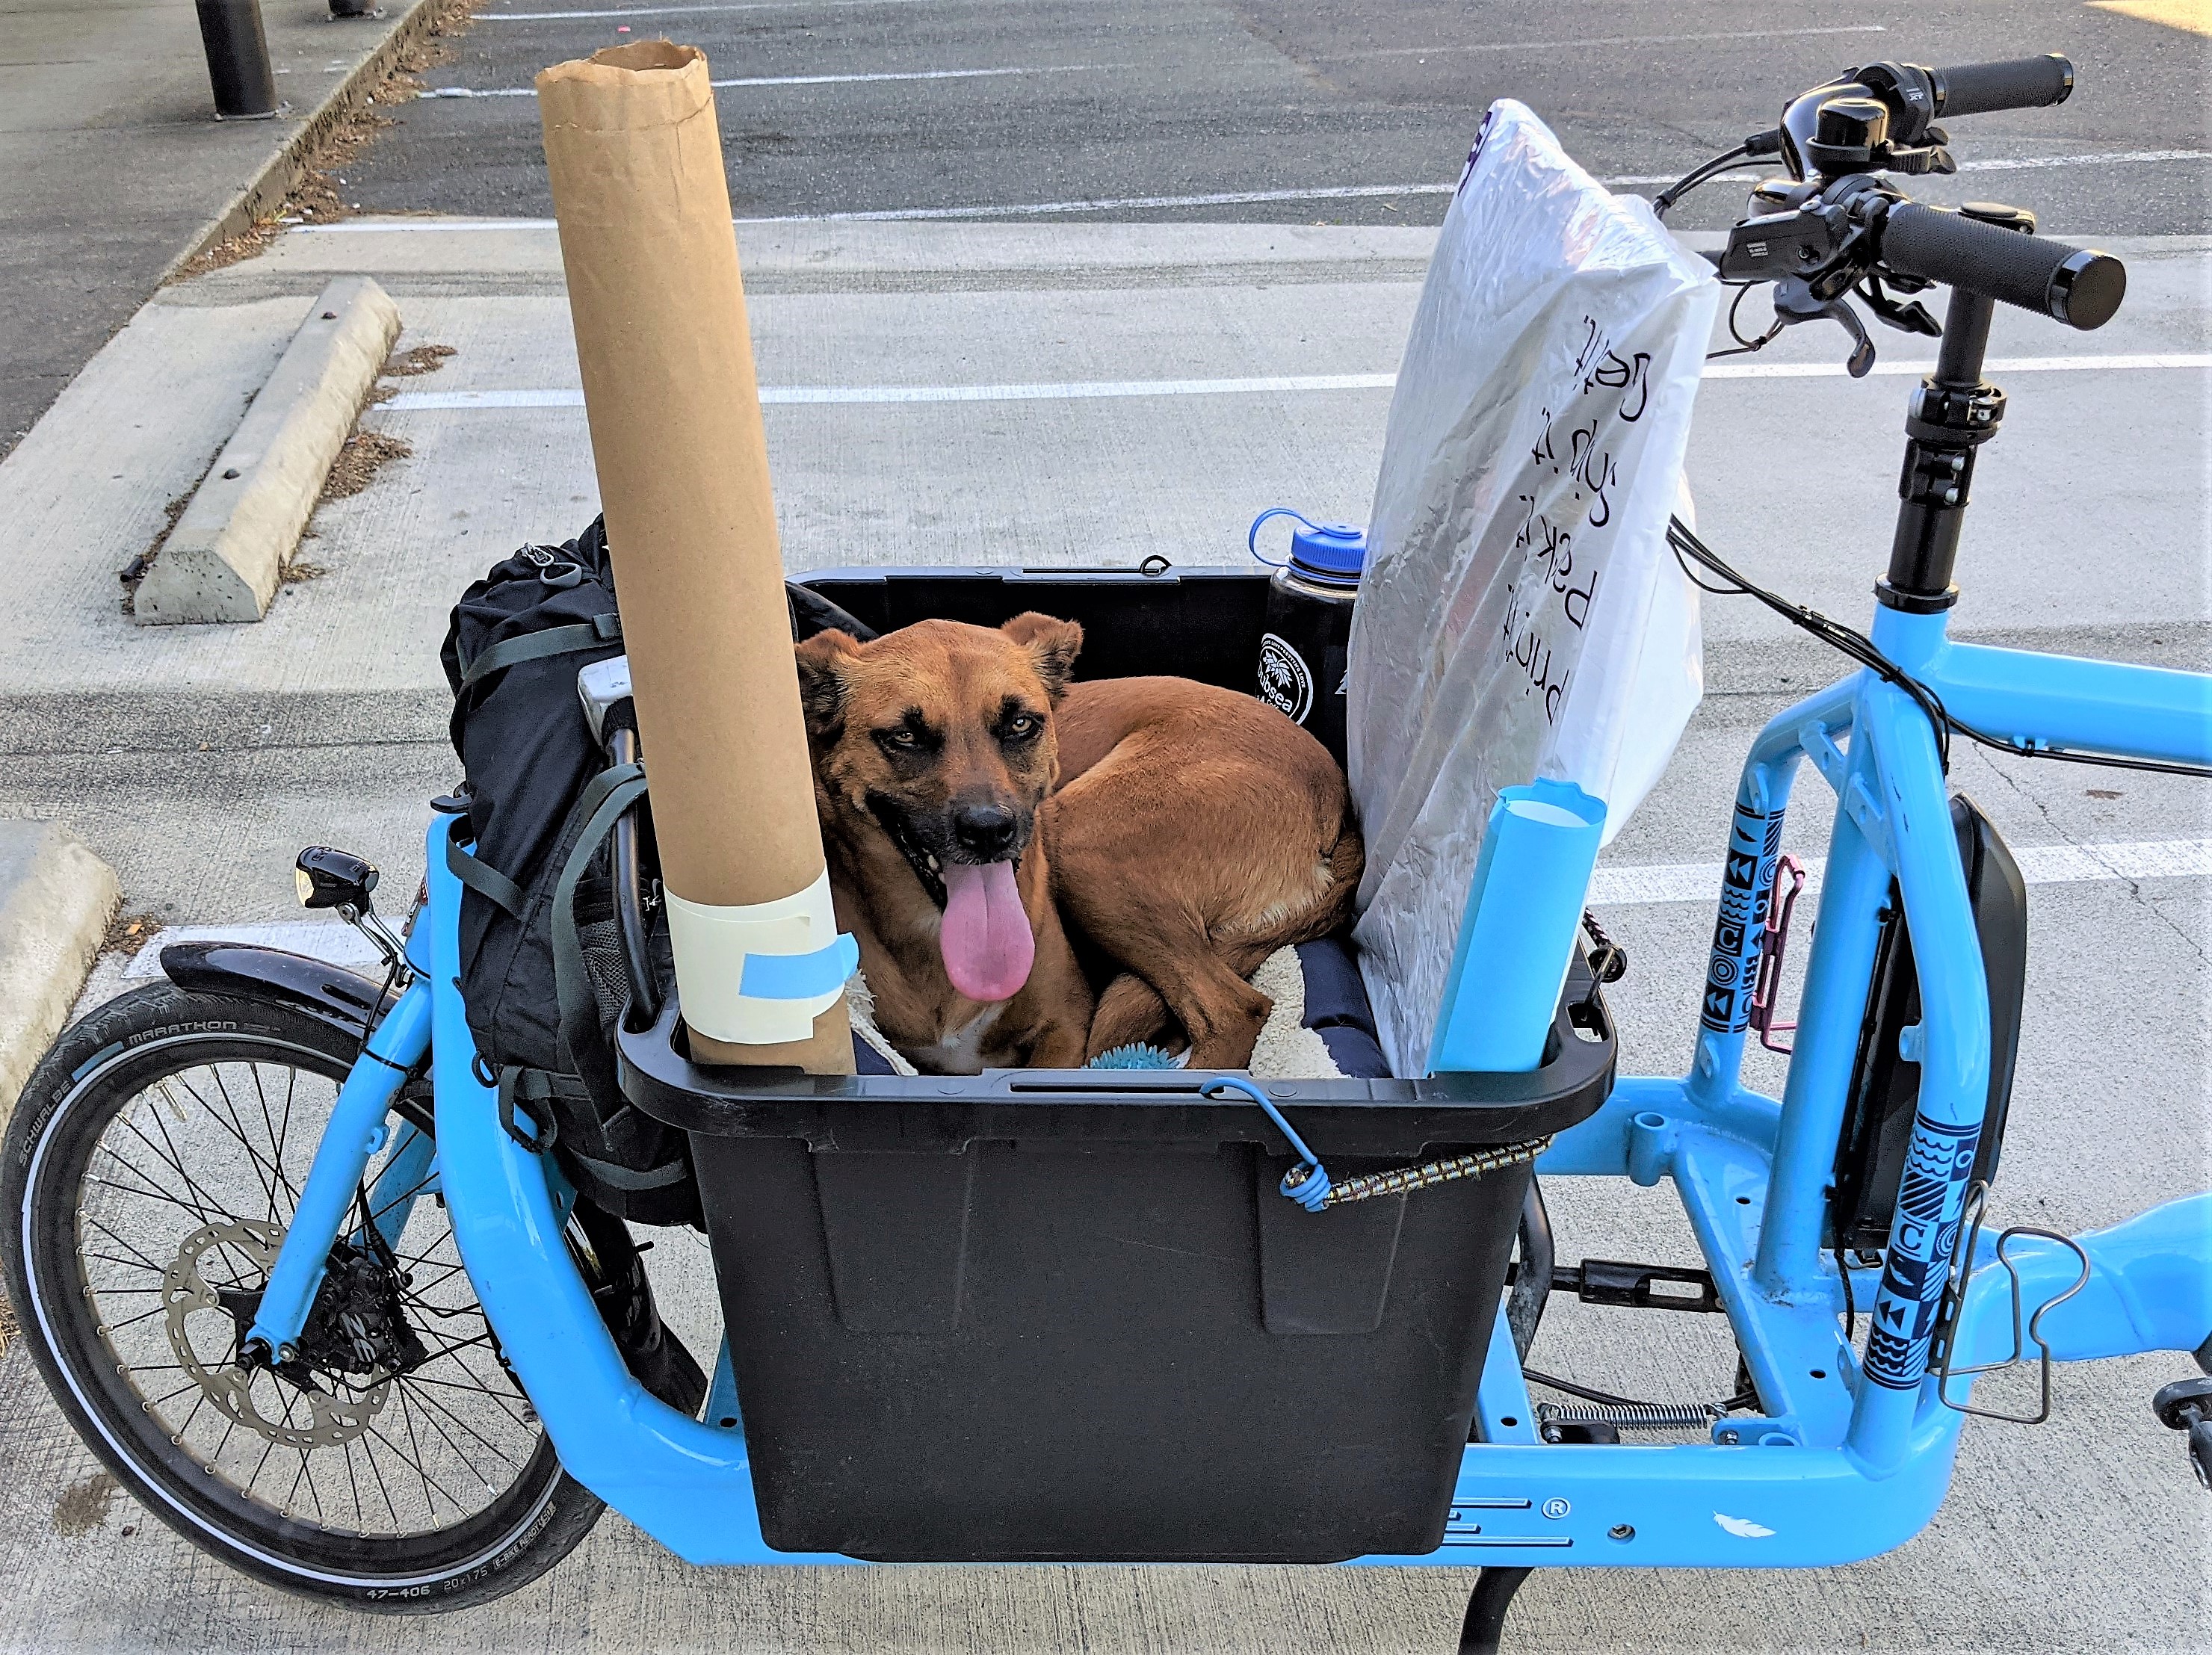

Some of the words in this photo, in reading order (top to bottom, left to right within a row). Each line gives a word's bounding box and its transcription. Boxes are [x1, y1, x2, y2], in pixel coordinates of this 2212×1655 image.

[129, 1020, 238, 1046] MARATHON
[19, 1080, 71, 1167] SCHWALBE
[366, 1585, 431, 1600] 47-406
